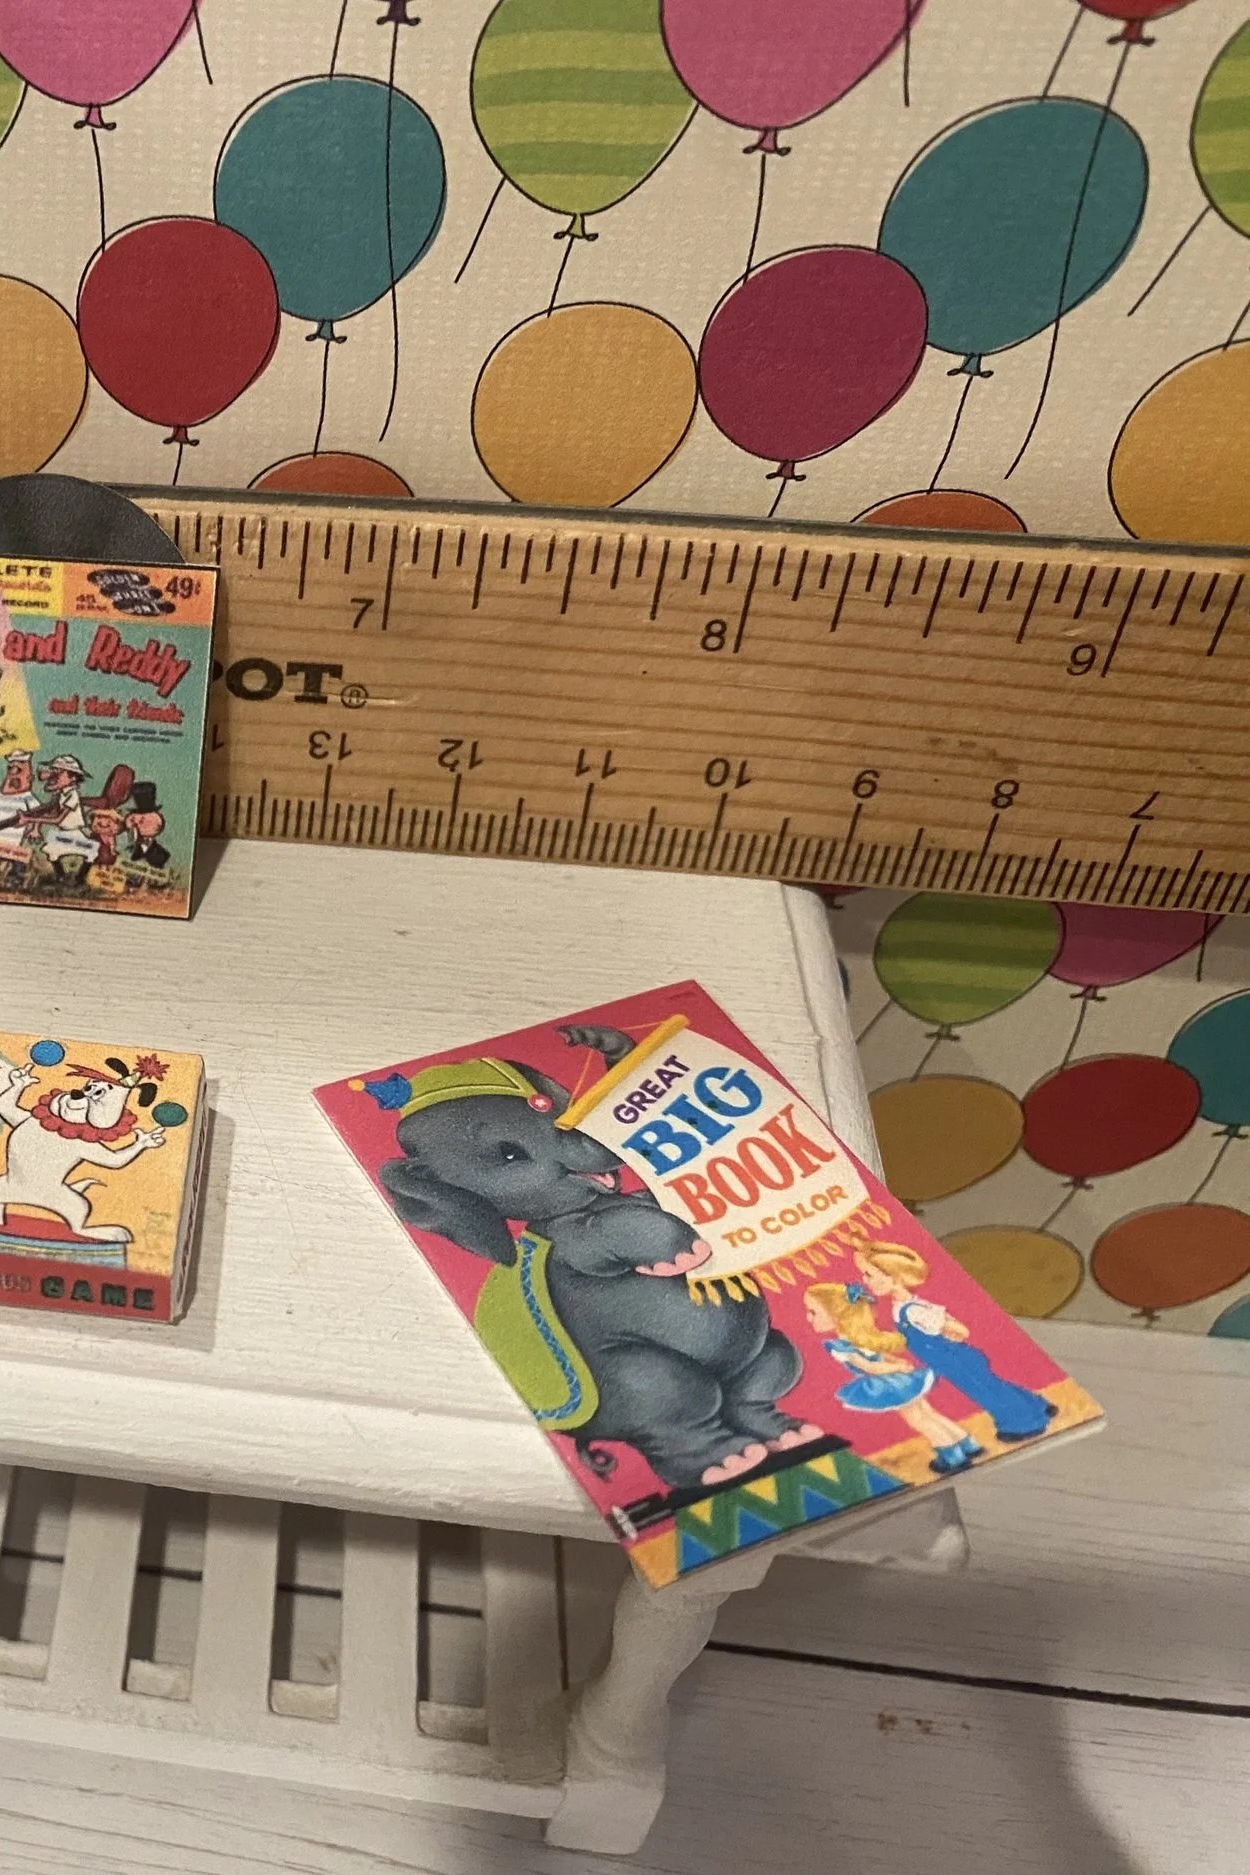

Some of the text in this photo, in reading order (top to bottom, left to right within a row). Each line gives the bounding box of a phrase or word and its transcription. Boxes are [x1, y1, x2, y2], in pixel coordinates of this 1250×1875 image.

[2, 599, 50, 610] RECORD
[350, 598, 375, 630] 7
[700, 618, 727, 652] 8
[3, 620, 68, 665] and
[85, 624, 191, 699] Reddy
[1066, 643, 1097, 677] 9
[308, 730, 353, 762] 13
[437, 738, 484, 772] 12
[704, 757, 752, 790] 10
[852, 769, 880, 800] 9
[991, 779, 1020, 810] 8
[1130, 790, 1161, 821] 7
[612, 1054, 691, 1125] GREAT
[621, 1066, 764, 1177] BIG
[663, 1102, 836, 1226] BOOK
[720, 1184, 849, 1249] TO COLOR
[40, 1275, 156, 1311] GAME
